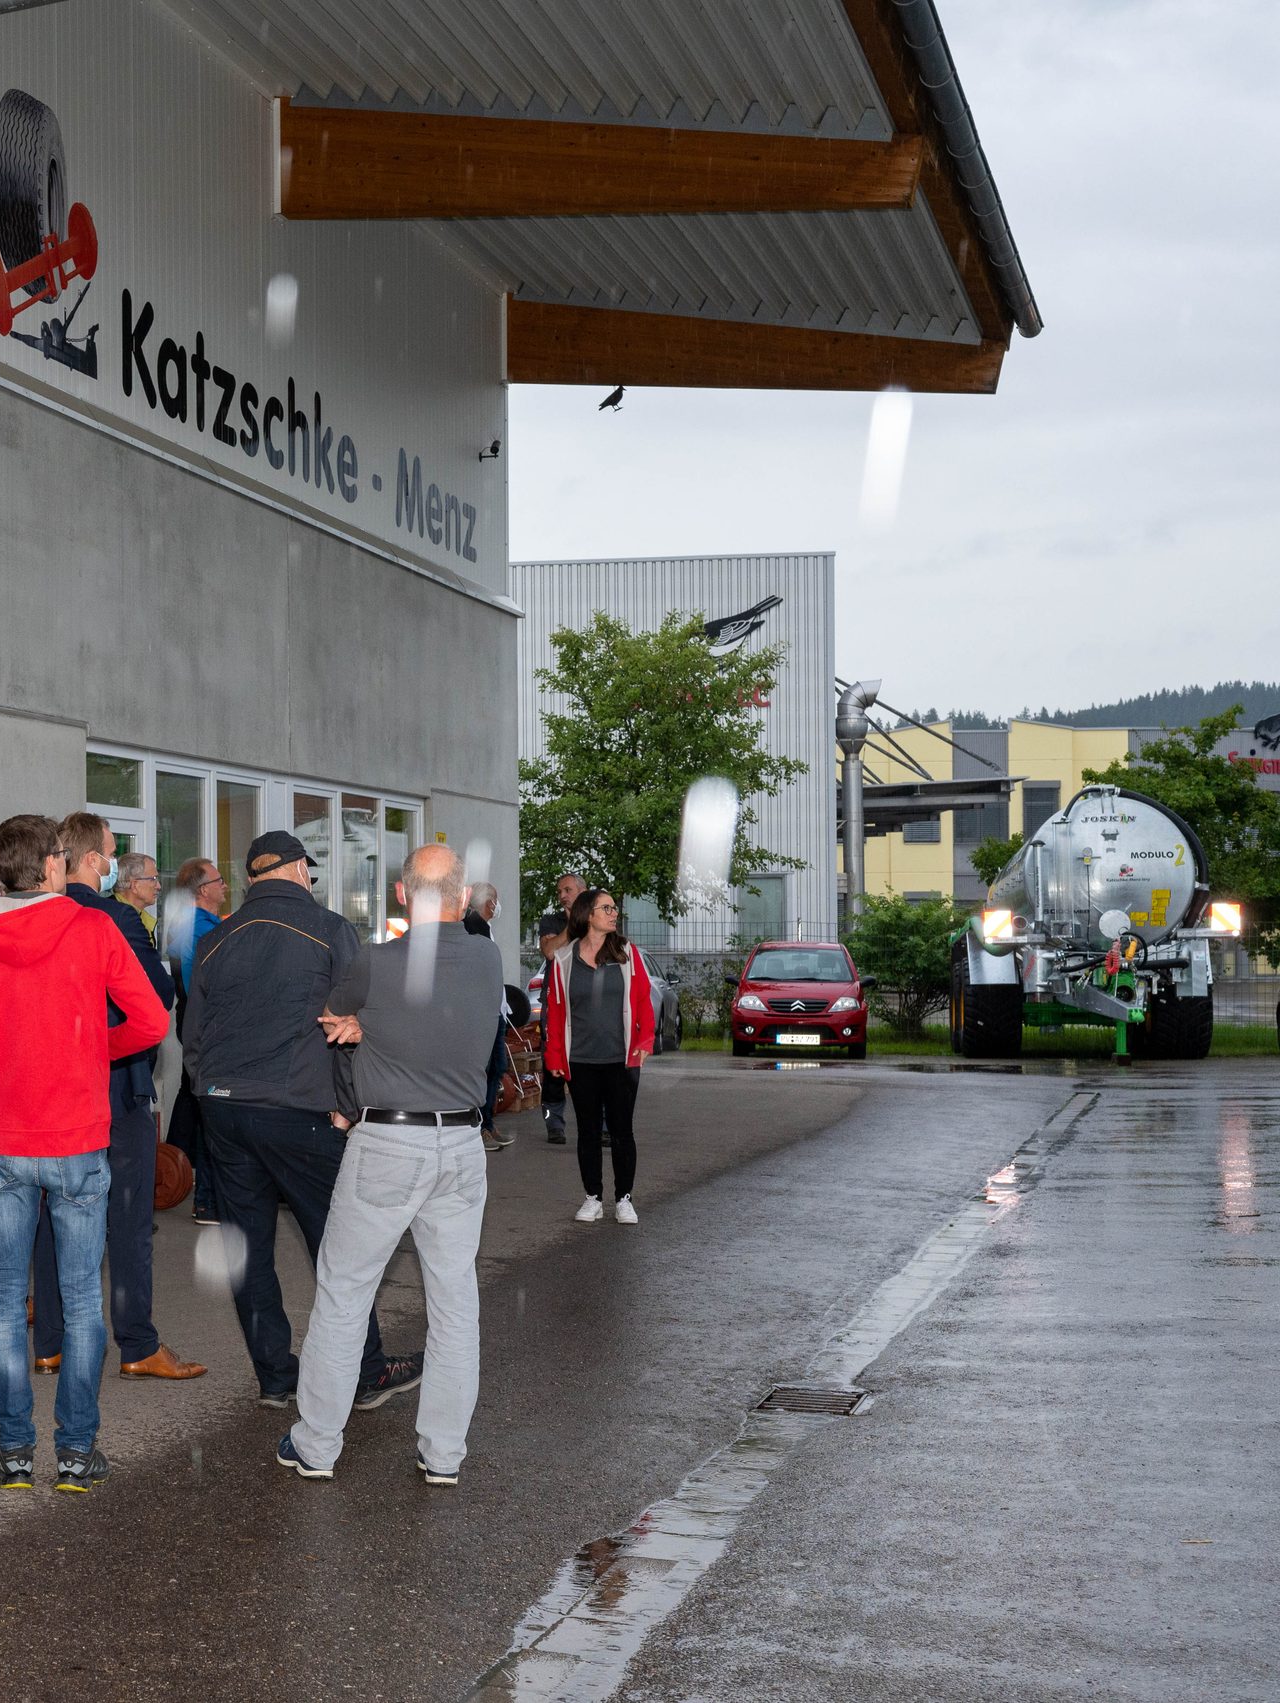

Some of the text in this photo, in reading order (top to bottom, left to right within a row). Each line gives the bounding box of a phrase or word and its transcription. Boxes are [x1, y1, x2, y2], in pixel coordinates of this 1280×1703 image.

[121, 288, 359, 504] Katzschke
[395, 447, 477, 563] Menz
[1081, 814, 1137, 824] JOSKIN
[1131, 851, 1174, 859] MODULO
